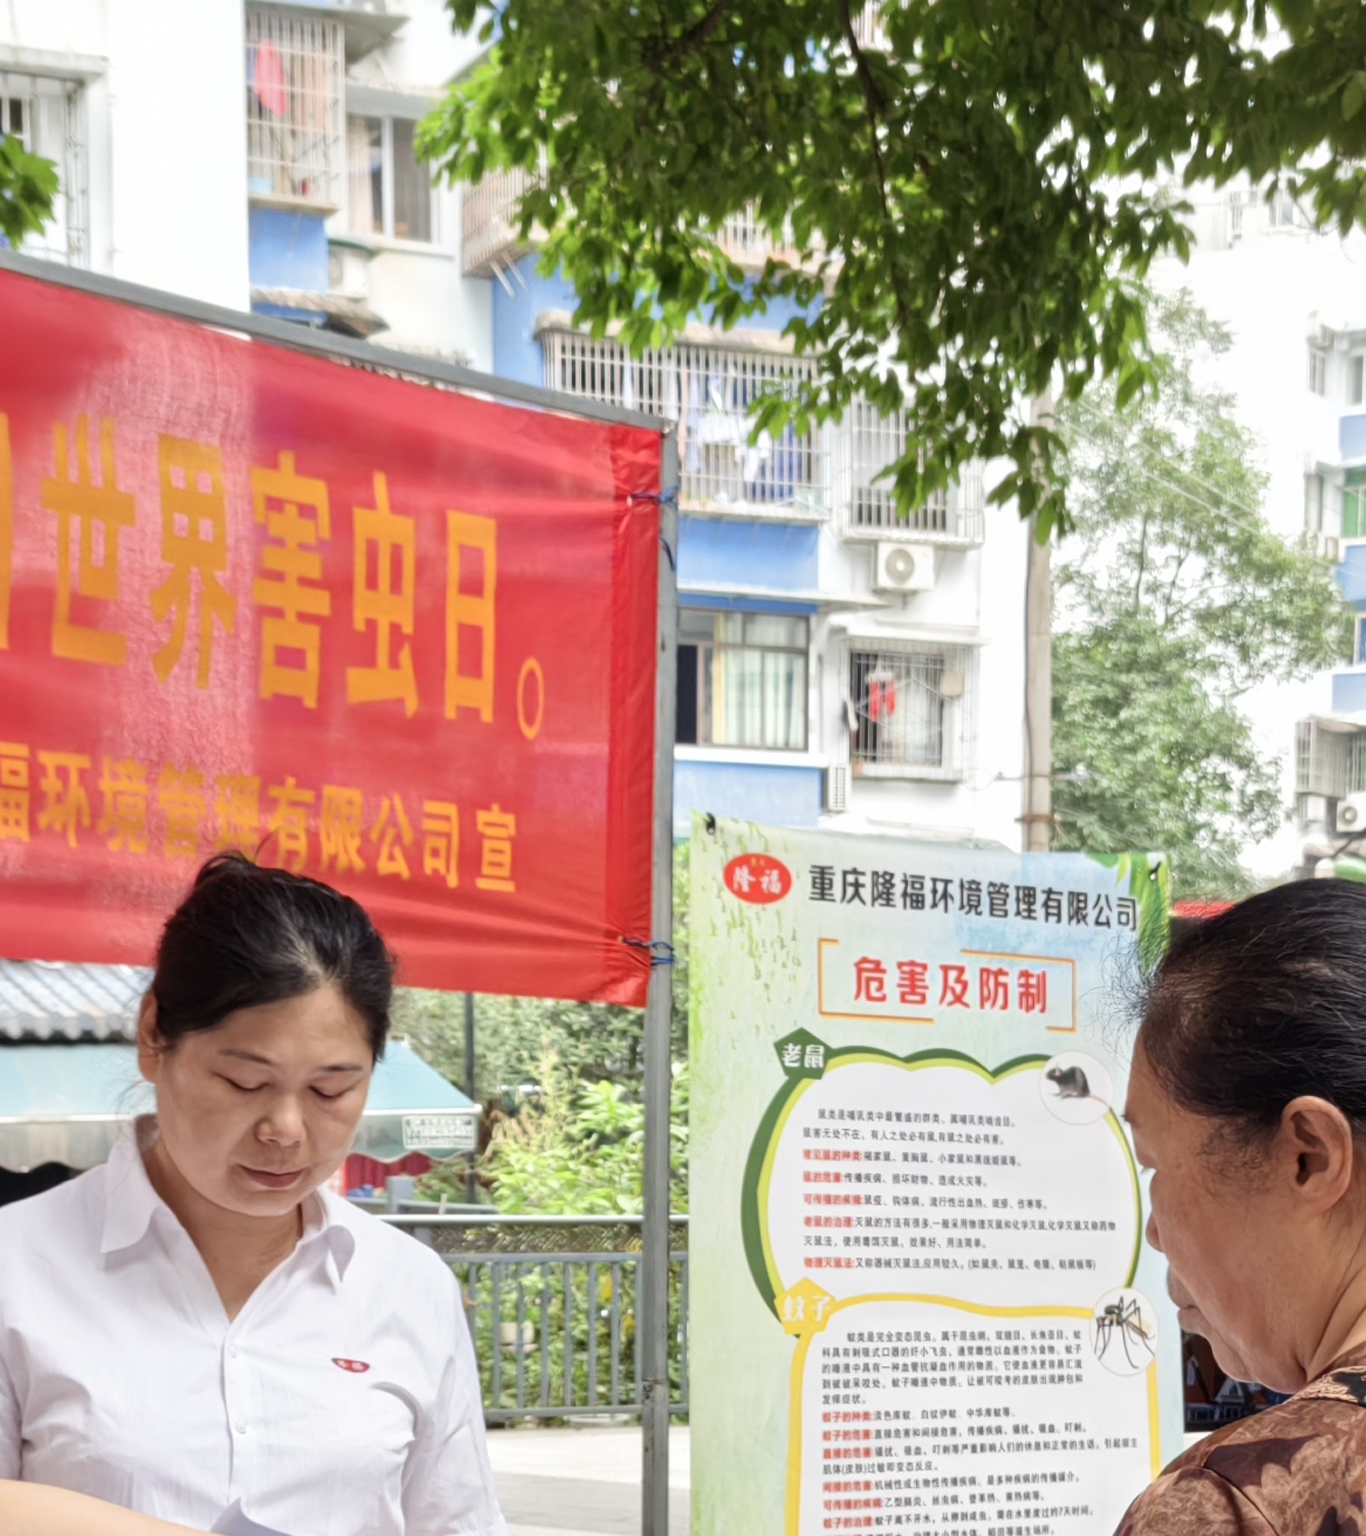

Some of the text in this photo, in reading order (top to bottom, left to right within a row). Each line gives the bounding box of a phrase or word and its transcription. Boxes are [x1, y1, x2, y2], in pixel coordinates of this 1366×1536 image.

[732, 864, 782, 894] 隆福
[809, 864, 1137, 932] 重庆隆福环境管理有限公司
[853, 956, 1048, 1014] 危害及防制
[782, 1042, 825, 1069] 老鼠
[782, 1294, 832, 1323] 蚊子
